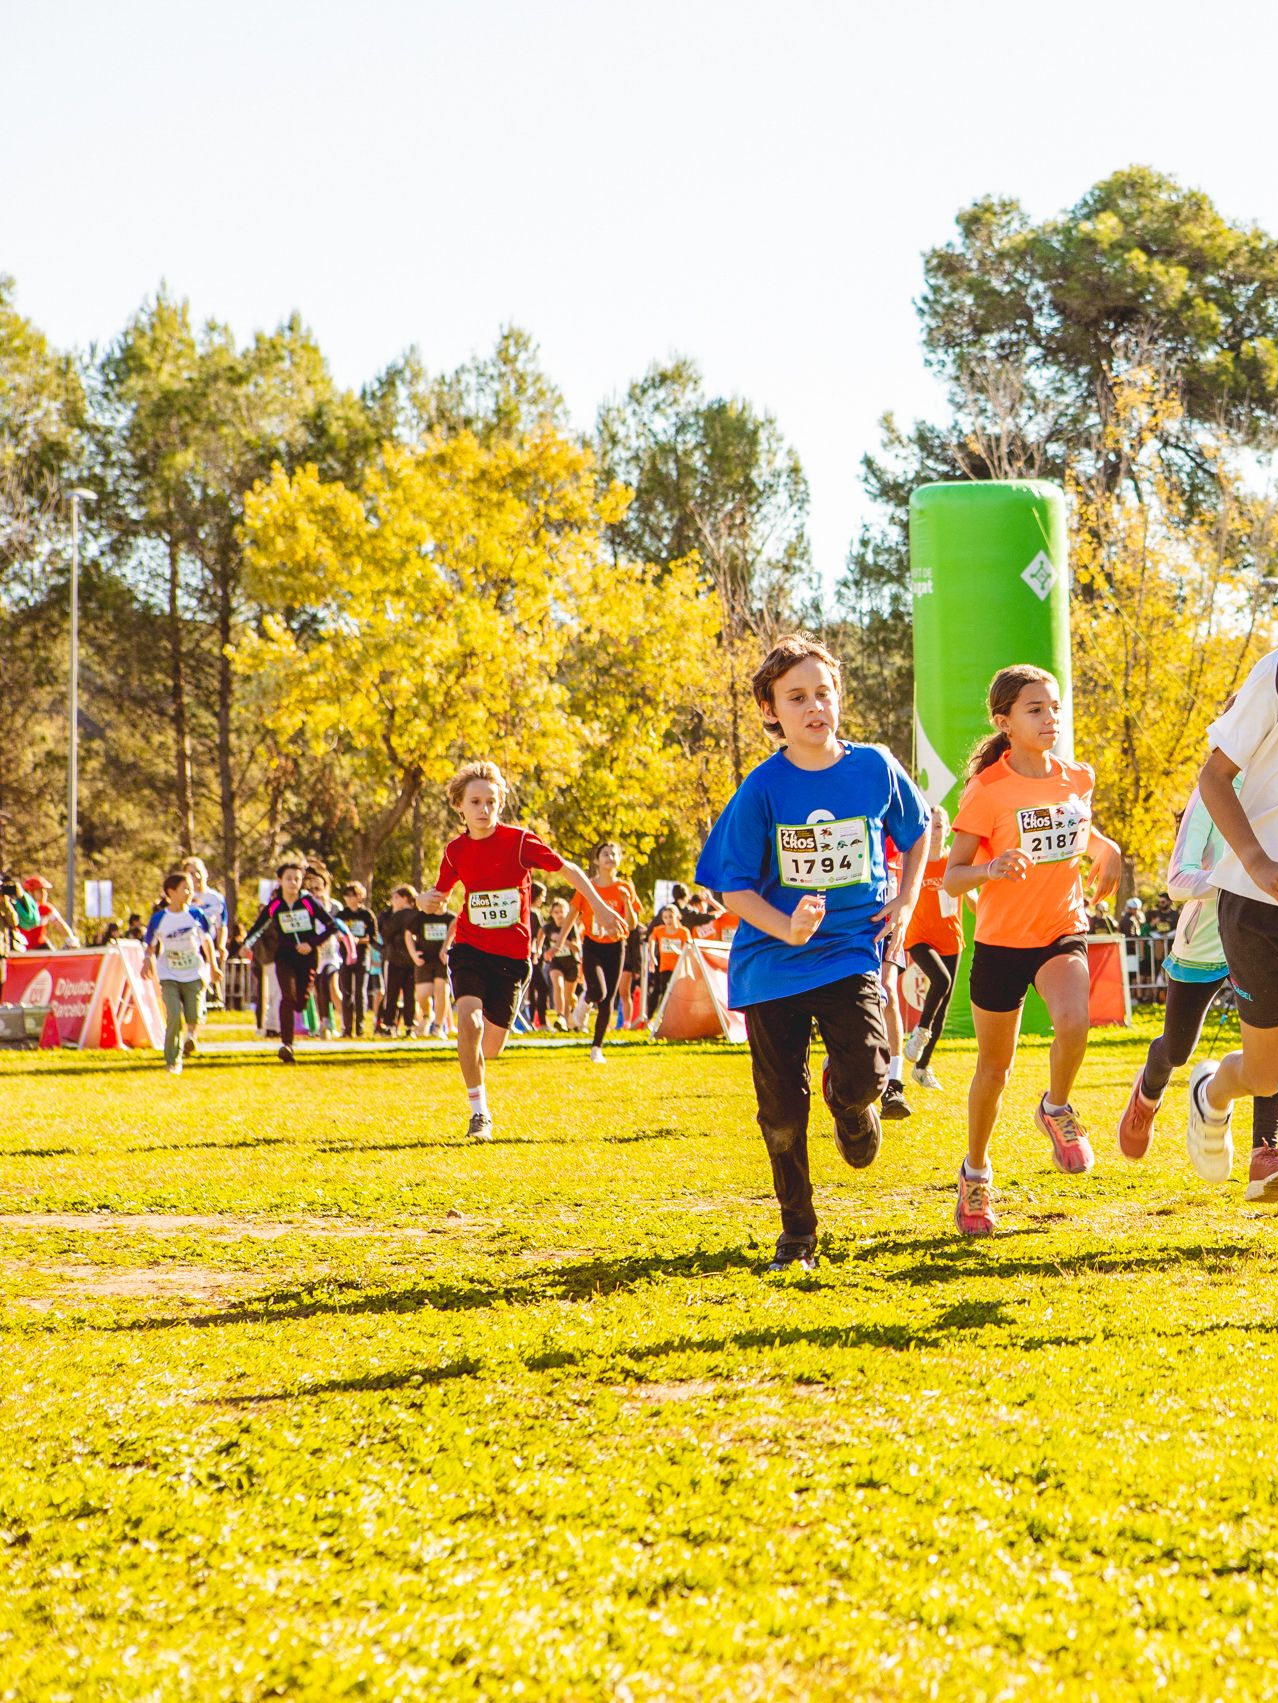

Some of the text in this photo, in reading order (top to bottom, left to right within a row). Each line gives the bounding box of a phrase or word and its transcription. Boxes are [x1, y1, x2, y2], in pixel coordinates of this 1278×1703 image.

[1023, 816, 1051, 829] CROS
[782, 837, 815, 849] CROS
[1031, 831, 1078, 852] 2187
[791, 855, 852, 875] 1794
[481, 909, 508, 921] 198
